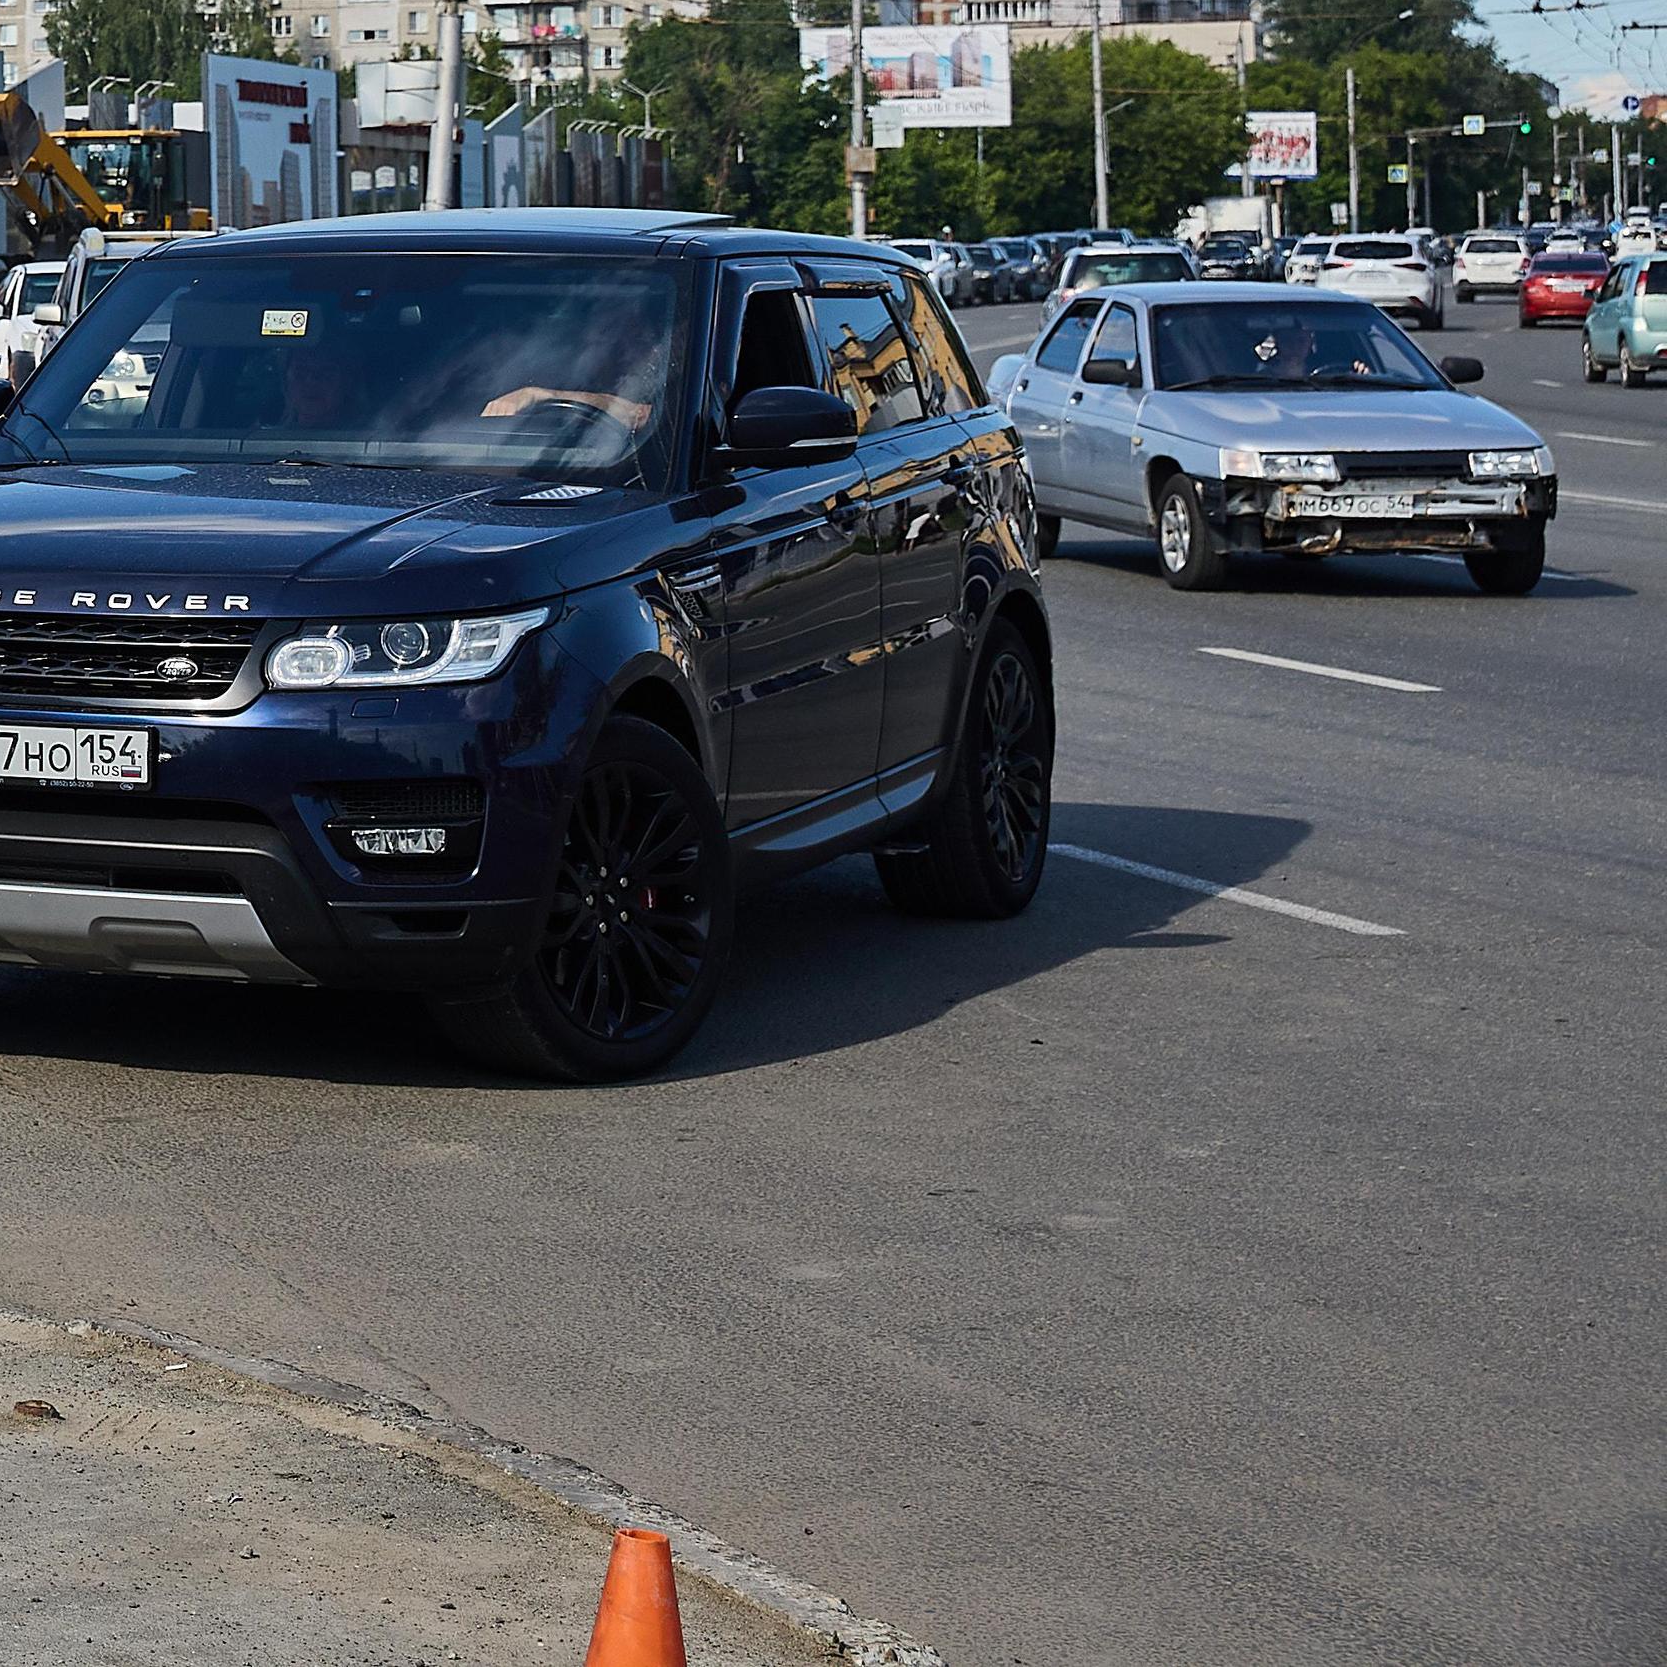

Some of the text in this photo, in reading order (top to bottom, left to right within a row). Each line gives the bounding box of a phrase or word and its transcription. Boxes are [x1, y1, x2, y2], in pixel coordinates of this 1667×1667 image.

[72, 592, 250, 610] ROVER
[79, 734, 136, 765] 154
[91, 764, 120, 776] RUS
